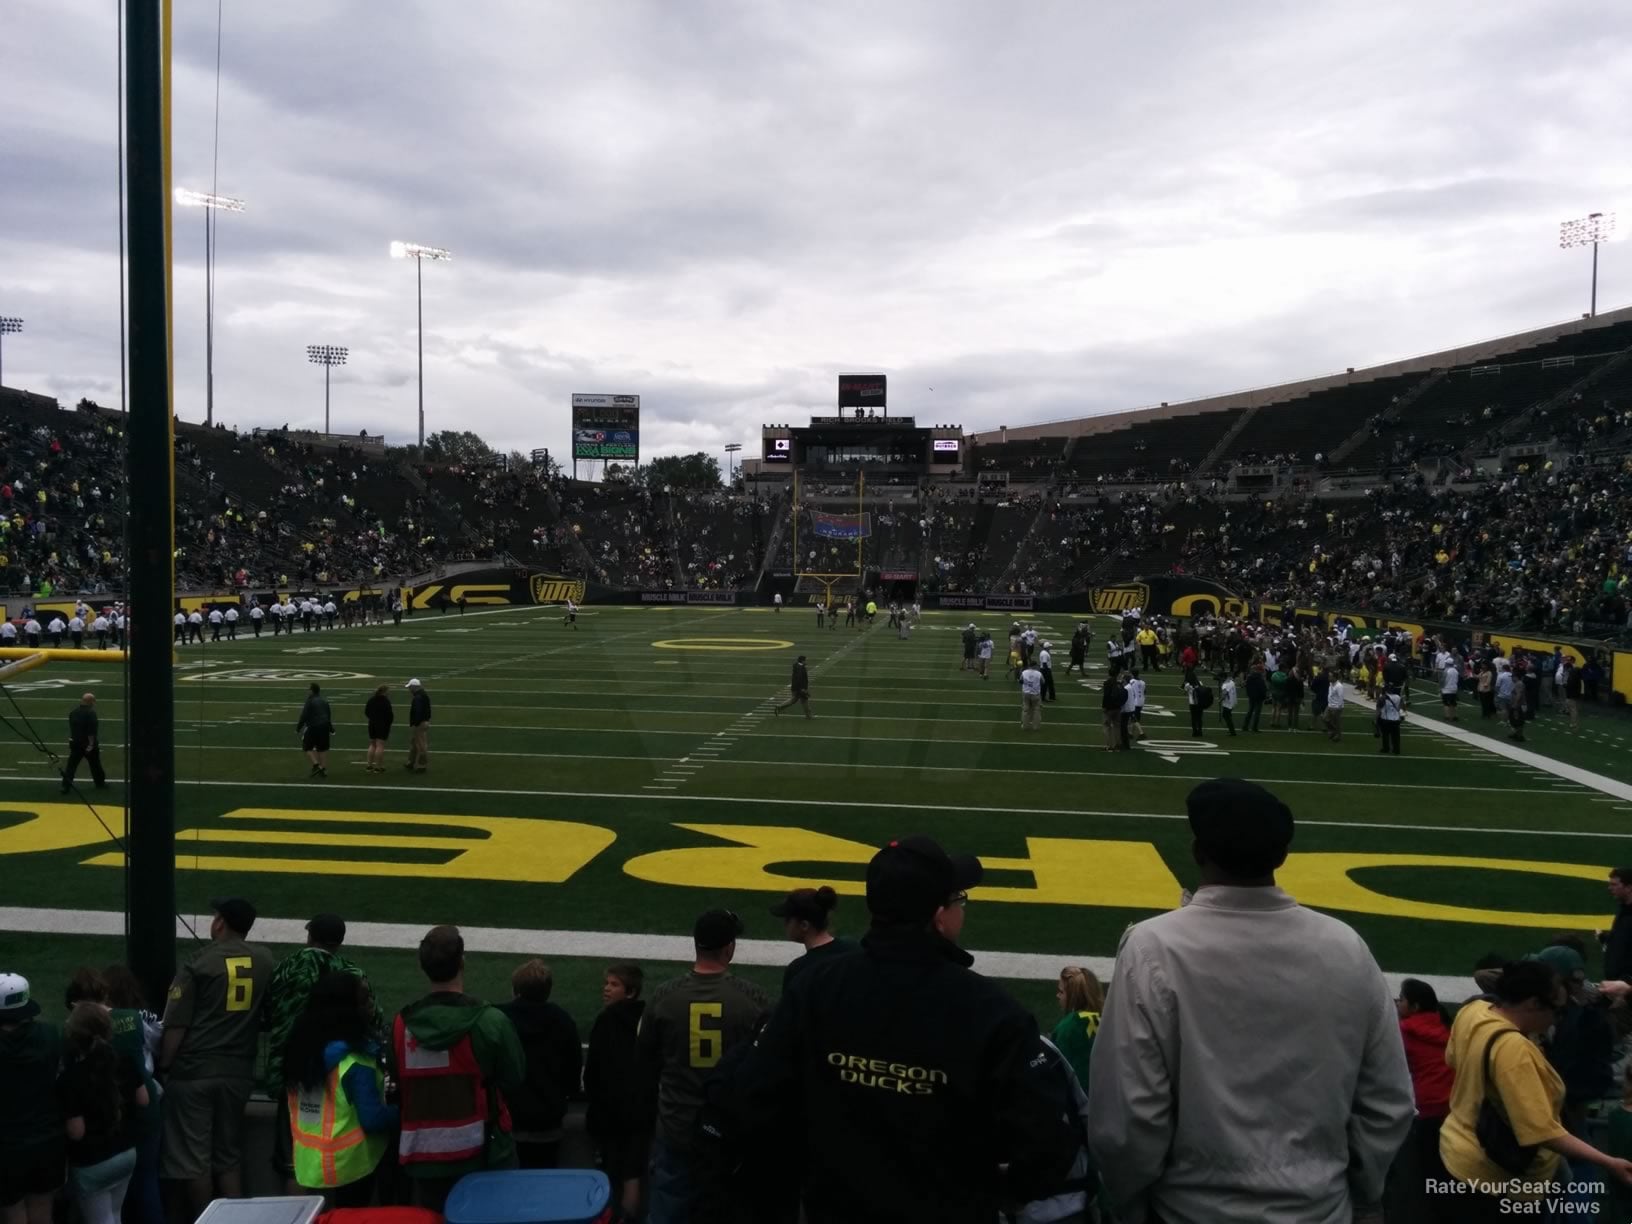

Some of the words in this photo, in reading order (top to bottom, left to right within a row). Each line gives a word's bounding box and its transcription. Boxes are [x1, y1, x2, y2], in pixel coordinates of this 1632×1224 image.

[820, 416, 840, 424] RICH
[844, 416, 877, 424] BROOKS
[881, 416, 903, 424] FIELD
[641, 593, 668, 601] MUSCLE
[668, 593, 686, 601] MILK
[689, 593, 714, 602] MUSCLE
[715, 593, 733, 602] MILK
[940, 596, 967, 606] MUSCLE
[967, 597, 985, 606] MILK
[987, 598, 1013, 607] MUSCLE
[1014, 599, 1031, 607] MILK
[224, 955, 254, 1013] 6
[688, 1000, 724, 1070] 6
[827, 1051, 948, 1085] OREGON
[840, 1069, 934, 1095] DUCKS
